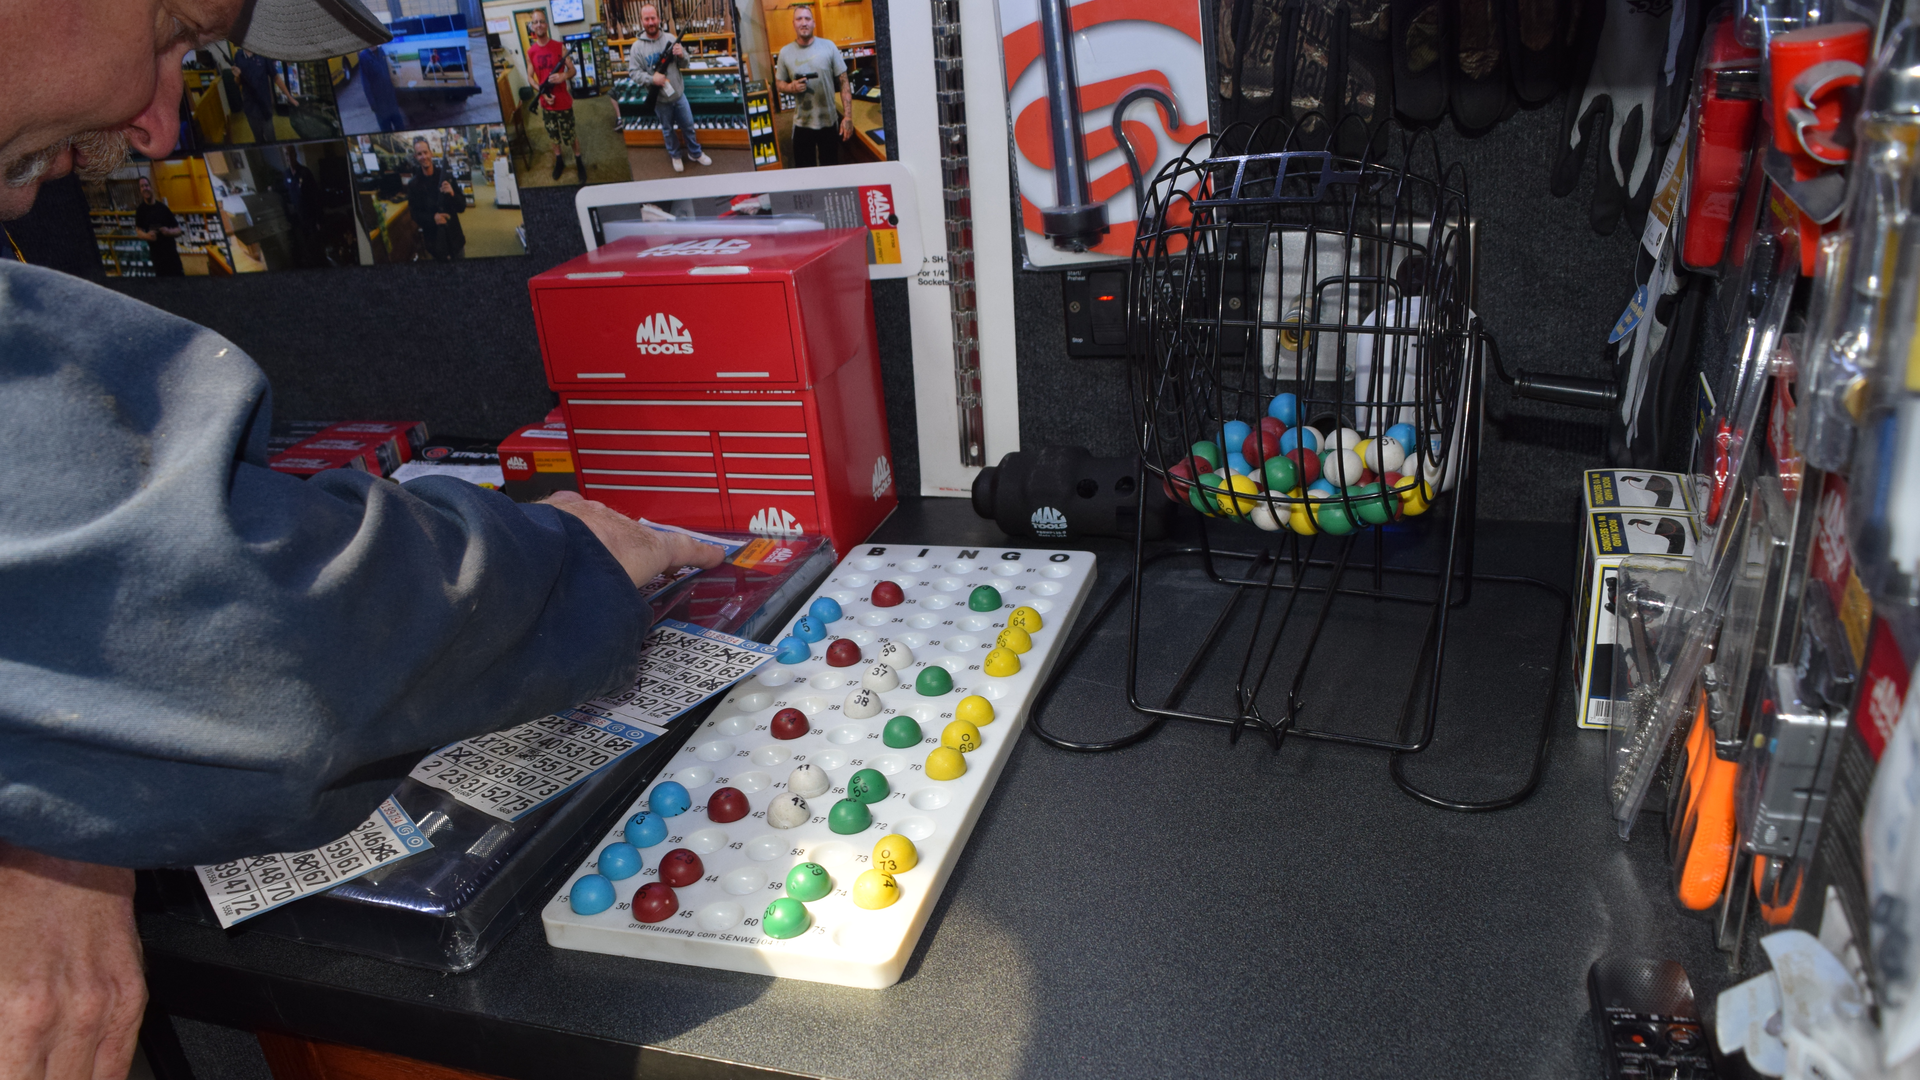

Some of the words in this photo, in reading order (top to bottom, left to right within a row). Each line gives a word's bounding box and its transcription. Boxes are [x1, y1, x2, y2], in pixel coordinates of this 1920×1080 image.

[867, 191, 877, 225] TOOLS
[873, 190, 890, 225] MAC
[637, 249, 742, 258] TOOLS
[648, 239, 751, 252] MAC
[918, 278, 949, 286] Sockets
[636, 312, 692, 344] MAC
[637, 343, 694, 355] TOOLS
[506, 456, 527, 466] MAC
[507, 463, 528, 471] TOOLS
[872, 455, 891, 492] MAC
[1602, 476, 1611, 488] ROCK
[873, 475, 892, 501] TOOLS
[1604, 488, 1613, 501] HARD
[749, 507, 803, 534] MAC
[1031, 506, 1067, 524] MAC
[1608, 519, 1619, 532] ROCK
[1611, 532, 1622, 547] HARD
[1013, 617, 1026, 627] 64
[652, 648, 677, 659] 19
[672, 653, 696, 665] 34
[695, 660, 721, 673] 51
[717, 665, 745, 678] 63
[693, 642, 719, 654] 32
[738, 653, 764, 665] 61
[654, 666, 676, 676] 5540
[674, 671, 701, 685] 50
[872, 667, 888, 677] 37
[652, 683, 676, 697] 55
[677, 690, 703, 703] 70
[630, 696, 657, 709] 52
[655, 702, 681, 717] 72
[560, 720, 586, 735] 32
[583, 727, 608, 741] 51
[515, 729, 537, 742] 22
[537, 736, 562, 750] 40
[558, 743, 583, 758] 53
[583, 751, 609, 767] 70
[960, 743, 975, 753] 69
[491, 742, 517, 757] 29
[532, 757, 559, 772] 55
[559, 767, 585, 782] 71
[464, 755, 488, 770] 25
[486, 763, 508, 779] 39
[508, 771, 533, 787] 50
[532, 781, 560, 797] 73
[422, 760, 443, 772] 2
[438, 769, 462, 785] 23
[459, 778, 484, 793] 31
[481, 786, 508, 803] 52
[508, 795, 535, 812] 75
[853, 784, 868, 798] 56
[874, 822, 888, 830] 72
[363, 830, 387, 847] 46
[612, 830, 624, 838] 13
[668, 835, 683, 843] 28
[729, 842, 743, 850] 43
[790, 848, 805, 856] 58
[855, 854, 868, 863] 73
[326, 840, 354, 858] 59
[258, 865, 286, 884] 48
[337, 855, 364, 876] 61
[879, 860, 897, 871] 73
[224, 876, 250, 895] 47
[302, 868, 331, 887] 67
[585, 861, 596, 869] 14
[643, 867, 657, 876] 29
[705, 875, 719, 883] 44
[768, 882, 782, 890] 59
[834, 889, 847, 897] 74
[266, 881, 295, 902] 70
[231, 894, 260, 916] 72
[556, 895, 569, 903] 15
[615, 902, 631, 910] 30
[679, 910, 694, 918] 45
[743, 918, 758, 926] 60
[812, 926, 825, 935] 75
[628, 922, 717, 939] orientaltrading.com
